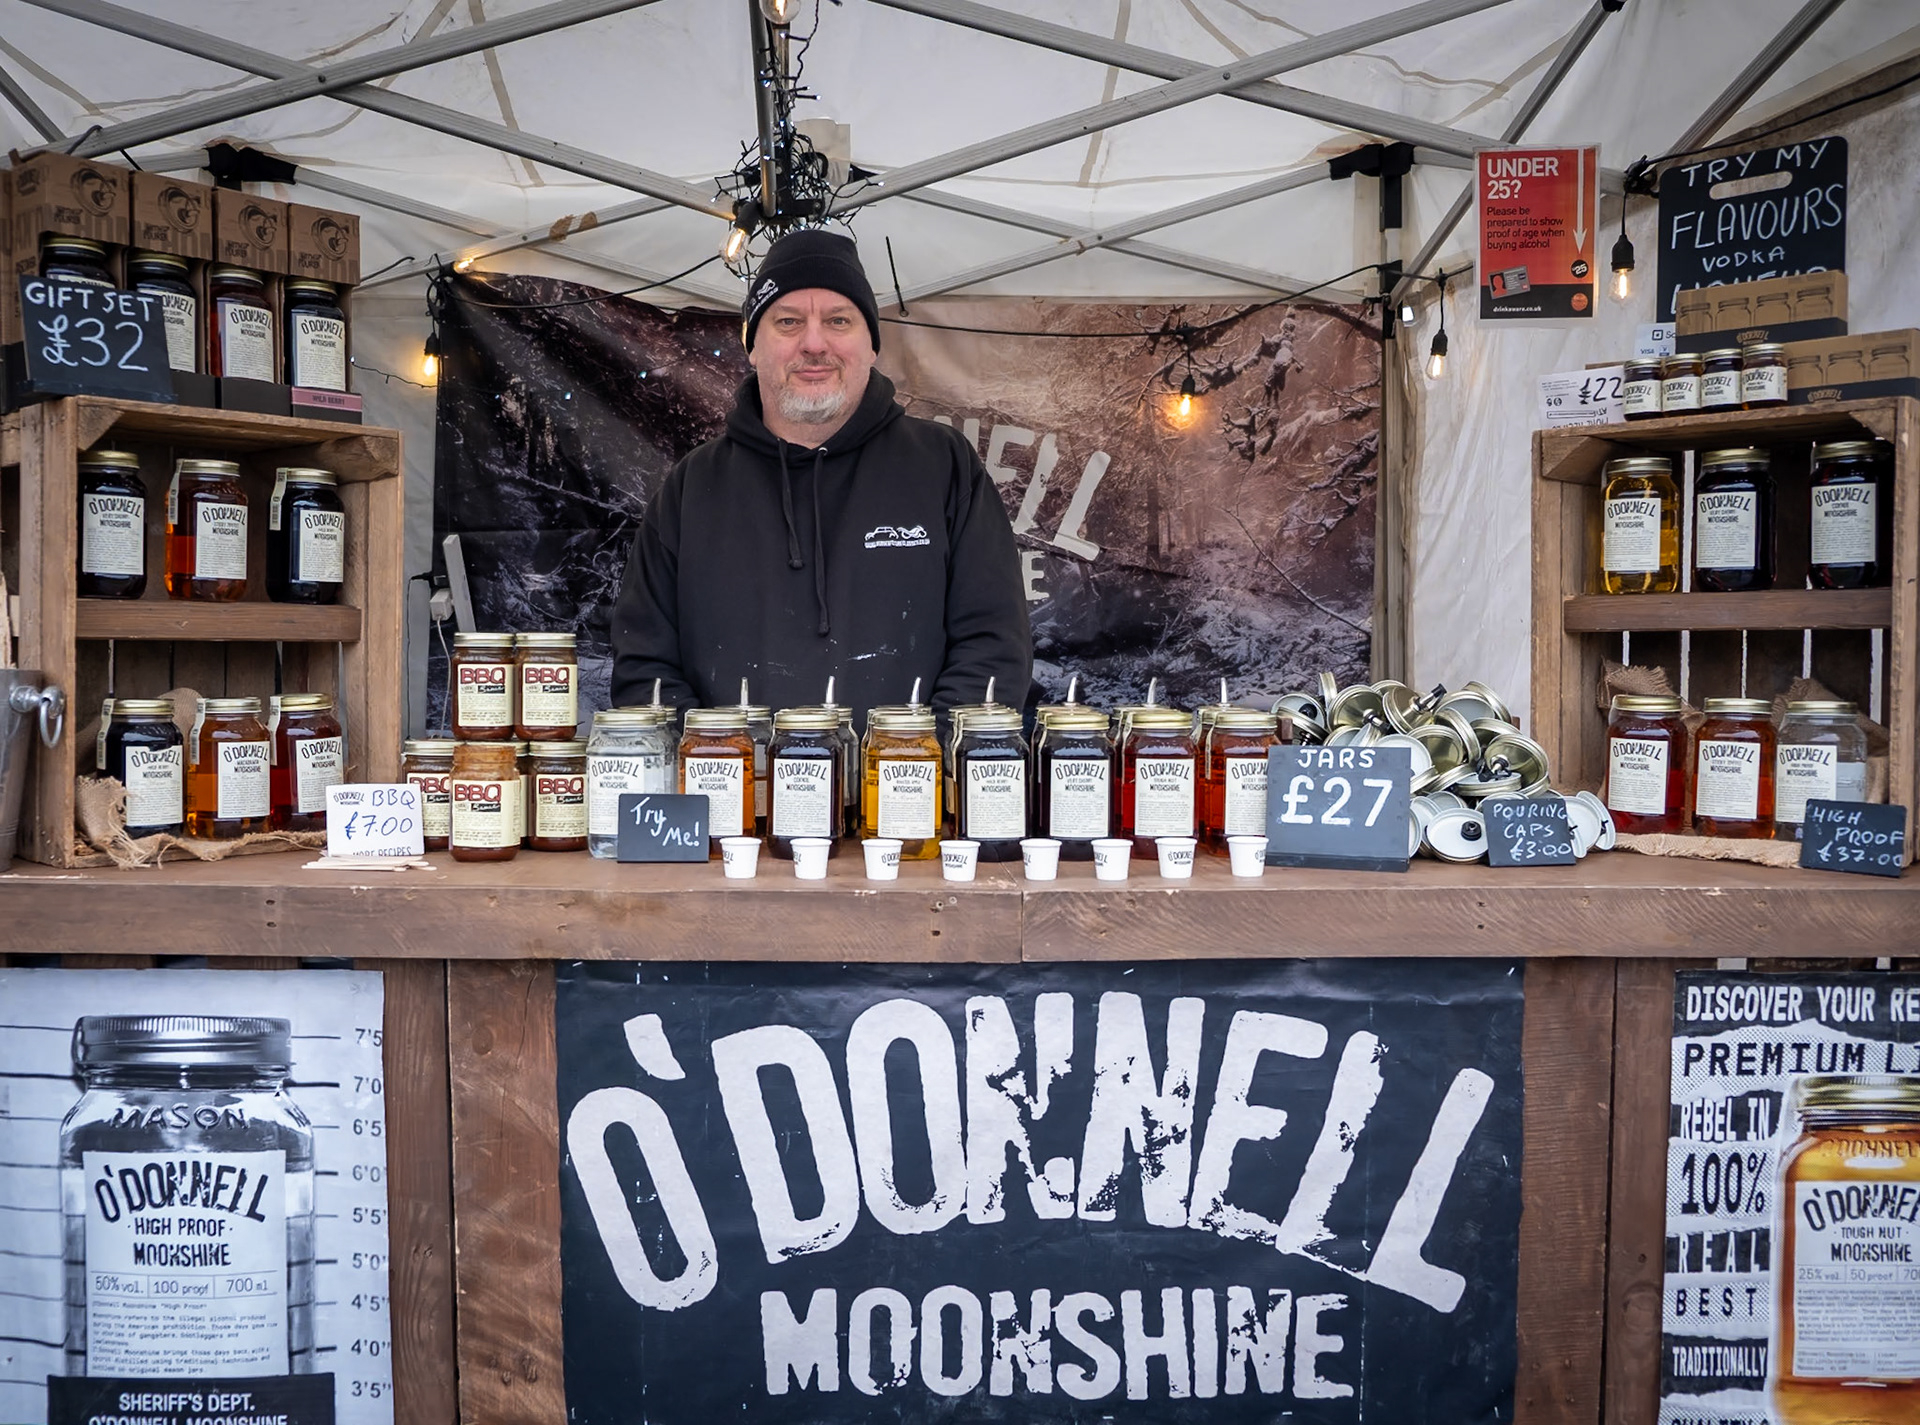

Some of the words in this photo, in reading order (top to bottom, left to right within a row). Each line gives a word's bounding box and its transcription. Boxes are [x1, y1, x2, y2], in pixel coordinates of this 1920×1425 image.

[1487, 157, 1559, 178] UNDER
[1681, 151, 1755, 187] TRY
[1775, 140, 1829, 169] MY
[1487, 179, 1522, 200] 25?
[1487, 206, 1517, 216] Please
[1519, 206, 1530, 215] be
[1671, 183, 1843, 249] FLAVOURS
[1487, 218, 1528, 229] prepared
[1530, 218, 1538, 226] to
[1540, 217, 1563, 226] show
[1487, 228, 1510, 239] proof
[1512, 228, 1521, 237] of
[1522, 229, 1539, 239] age
[1541, 228, 1565, 237] when
[1487, 241, 1517, 251] buying
[1519, 239, 1550, 249] alcohol
[1702, 246, 1785, 273] VODKA
[25, 282, 95, 310] GIFT
[102, 291, 154, 322] SET
[38, 314, 149, 371] £32
[1578, 376, 1624, 405] £22
[460, 667, 506, 684] BBQ
[525, 667, 570, 684] BBQ
[1297, 748, 1377, 768] JARS
[454, 783, 502, 803] BBQ
[539, 777, 584, 795] BBQ
[372, 788, 415, 809] BBQ
[1280, 775, 1393, 827] £27
[630, 797, 667, 837] Try
[1493, 803, 1568, 819] POURING
[1812, 806, 1861, 825] HIGH
[344, 811, 413, 840] £7.00
[662, 822, 699, 847] Me!
[1504, 823, 1554, 839] CAPS
[1835, 827, 1904, 846] PROOF
[1510, 838, 1572, 861] £3.00
[1817, 841, 1903, 867] £37.00
[1686, 985, 1803, 1022] DISCOVER
[1816, 985, 1875, 1022] YOUR
[1684, 1042, 1866, 1077] PREMIUM
[108, 1102, 250, 1131] MASON
[1681, 1098, 1736, 1142] REBEL
[1747, 1097, 1770, 1142] IN
[567, 990, 1495, 1313] O'DONNELL
[94, 1160, 269, 1224] O'DONNELL
[1681, 1152, 1768, 1215] 100%
[134, 1217, 172, 1236] HIGH
[178, 1217, 226, 1237] PROOF
[1841, 1226, 1874, 1239] TOUGH
[1878, 1226, 1902, 1239] NUT
[133, 1242, 232, 1267] MOONSHINE
[1678, 1231, 1760, 1274] REAL
[1831, 1243, 1913, 1262] MOONSHINE
[95, 1275, 119, 1292] 50%
[121, 1280, 144, 1294] vol.
[1798, 1268, 1822, 1280] 25%
[1850, 1268, 1866, 1280] 50
[153, 1281, 179, 1294] 100
[182, 1283, 209, 1296] proof
[226, 1278, 253, 1292] 700
[255, 1279, 268, 1291] ml
[1676, 1288, 1757, 1317] BEST
[760, 1285, 1354, 1400] MOONSHINE
[1672, 1346, 1767, 1377] TRADITIONALLY
[119, 1392, 203, 1412] SHERIFF'S
[207, 1393, 256, 1412] DEPT.
